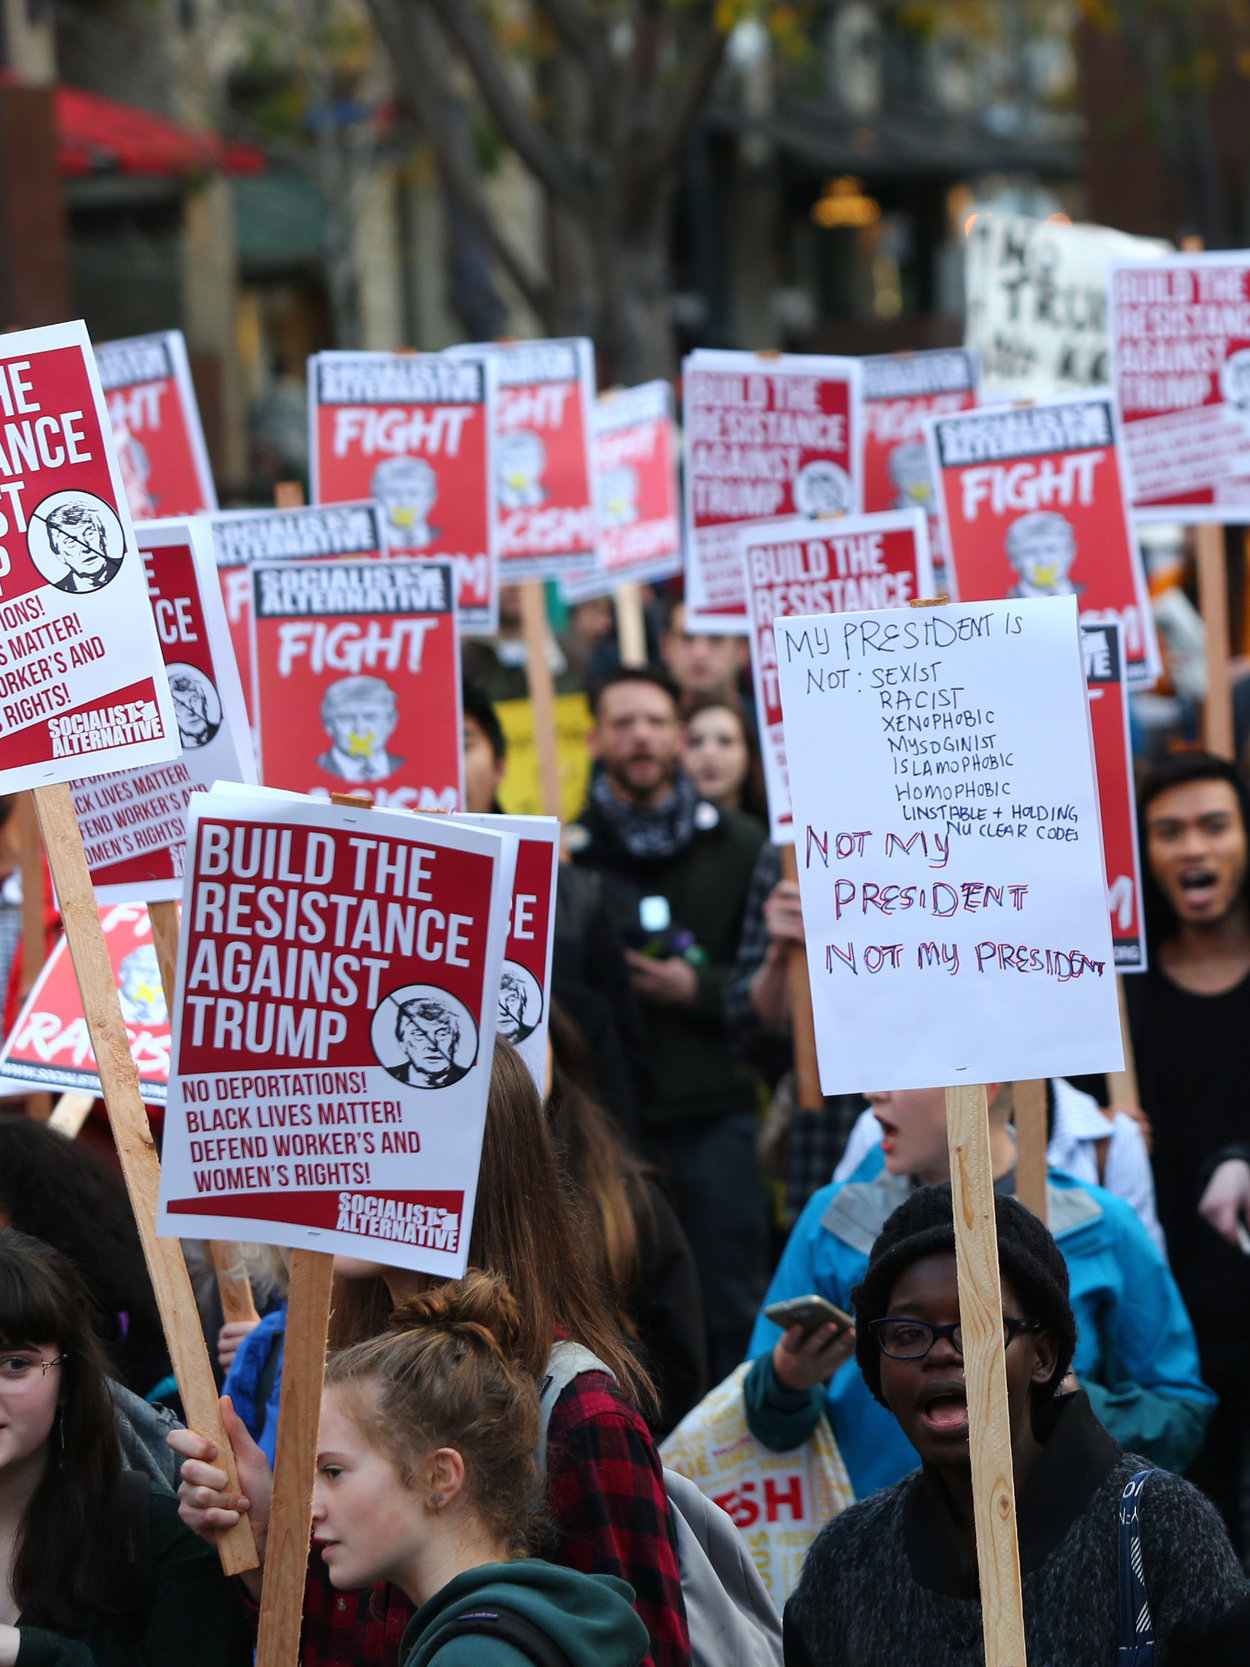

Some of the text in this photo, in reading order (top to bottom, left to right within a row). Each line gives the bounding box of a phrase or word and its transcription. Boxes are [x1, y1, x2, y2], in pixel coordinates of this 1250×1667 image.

[334, 407, 474, 458] FIGHT
[961, 451, 1105, 521] FIGHT
[750, 541, 829, 586] BUILD
[830, 533, 886, 576] THE
[262, 585, 446, 615] ALTERNATIVE
[754, 571, 913, 620] RESISTANCE
[8, 612, 83, 661] MATTER!
[69, 636, 106, 668] AND
[278, 619, 439, 678] FIGHT
[785, 613, 1024, 663] MY PRESIDENT IS
[870, 662, 942, 689] SEXIST
[3, 682, 71, 728] RIGHTS!
[880, 687, 964, 710] RACIST
[48, 702, 136, 739] SOCIALIST
[51, 718, 163, 758] ALTERNATIVE
[94, 781, 133, 808] LIVES
[132, 763, 190, 795] MATTER!
[112, 792, 181, 829] WORKER'S
[1011, 805, 1079, 823] HOLDING
[134, 817, 186, 848] RIGHTS!
[805, 824, 951, 869] NOT MY
[199, 824, 336, 886] BUILD
[349, 837, 437, 901] THE
[834, 878, 1029, 920] PRESIDENT
[194, 882, 474, 968] RESISTANCE
[187, 938, 390, 1010] AGAINST
[825, 940, 904, 976] NOT
[917, 941, 960, 976] MY
[974, 941, 1106, 982] PRESIDENT
[187, 995, 347, 1061] TRUMP
[183, 1072, 366, 1102] NO DEPORTATIONS!
[186, 1100, 402, 1133] BLACK LIVES MATTER!
[191, 1130, 421, 1163] DEFEND WORKER'S AND
[194, 1162, 371, 1193] WOMEN'S RIGHTS!
[338, 1192, 440, 1228] SOCIALIST
[336, 1211, 458, 1252] ALTERNATIVE
